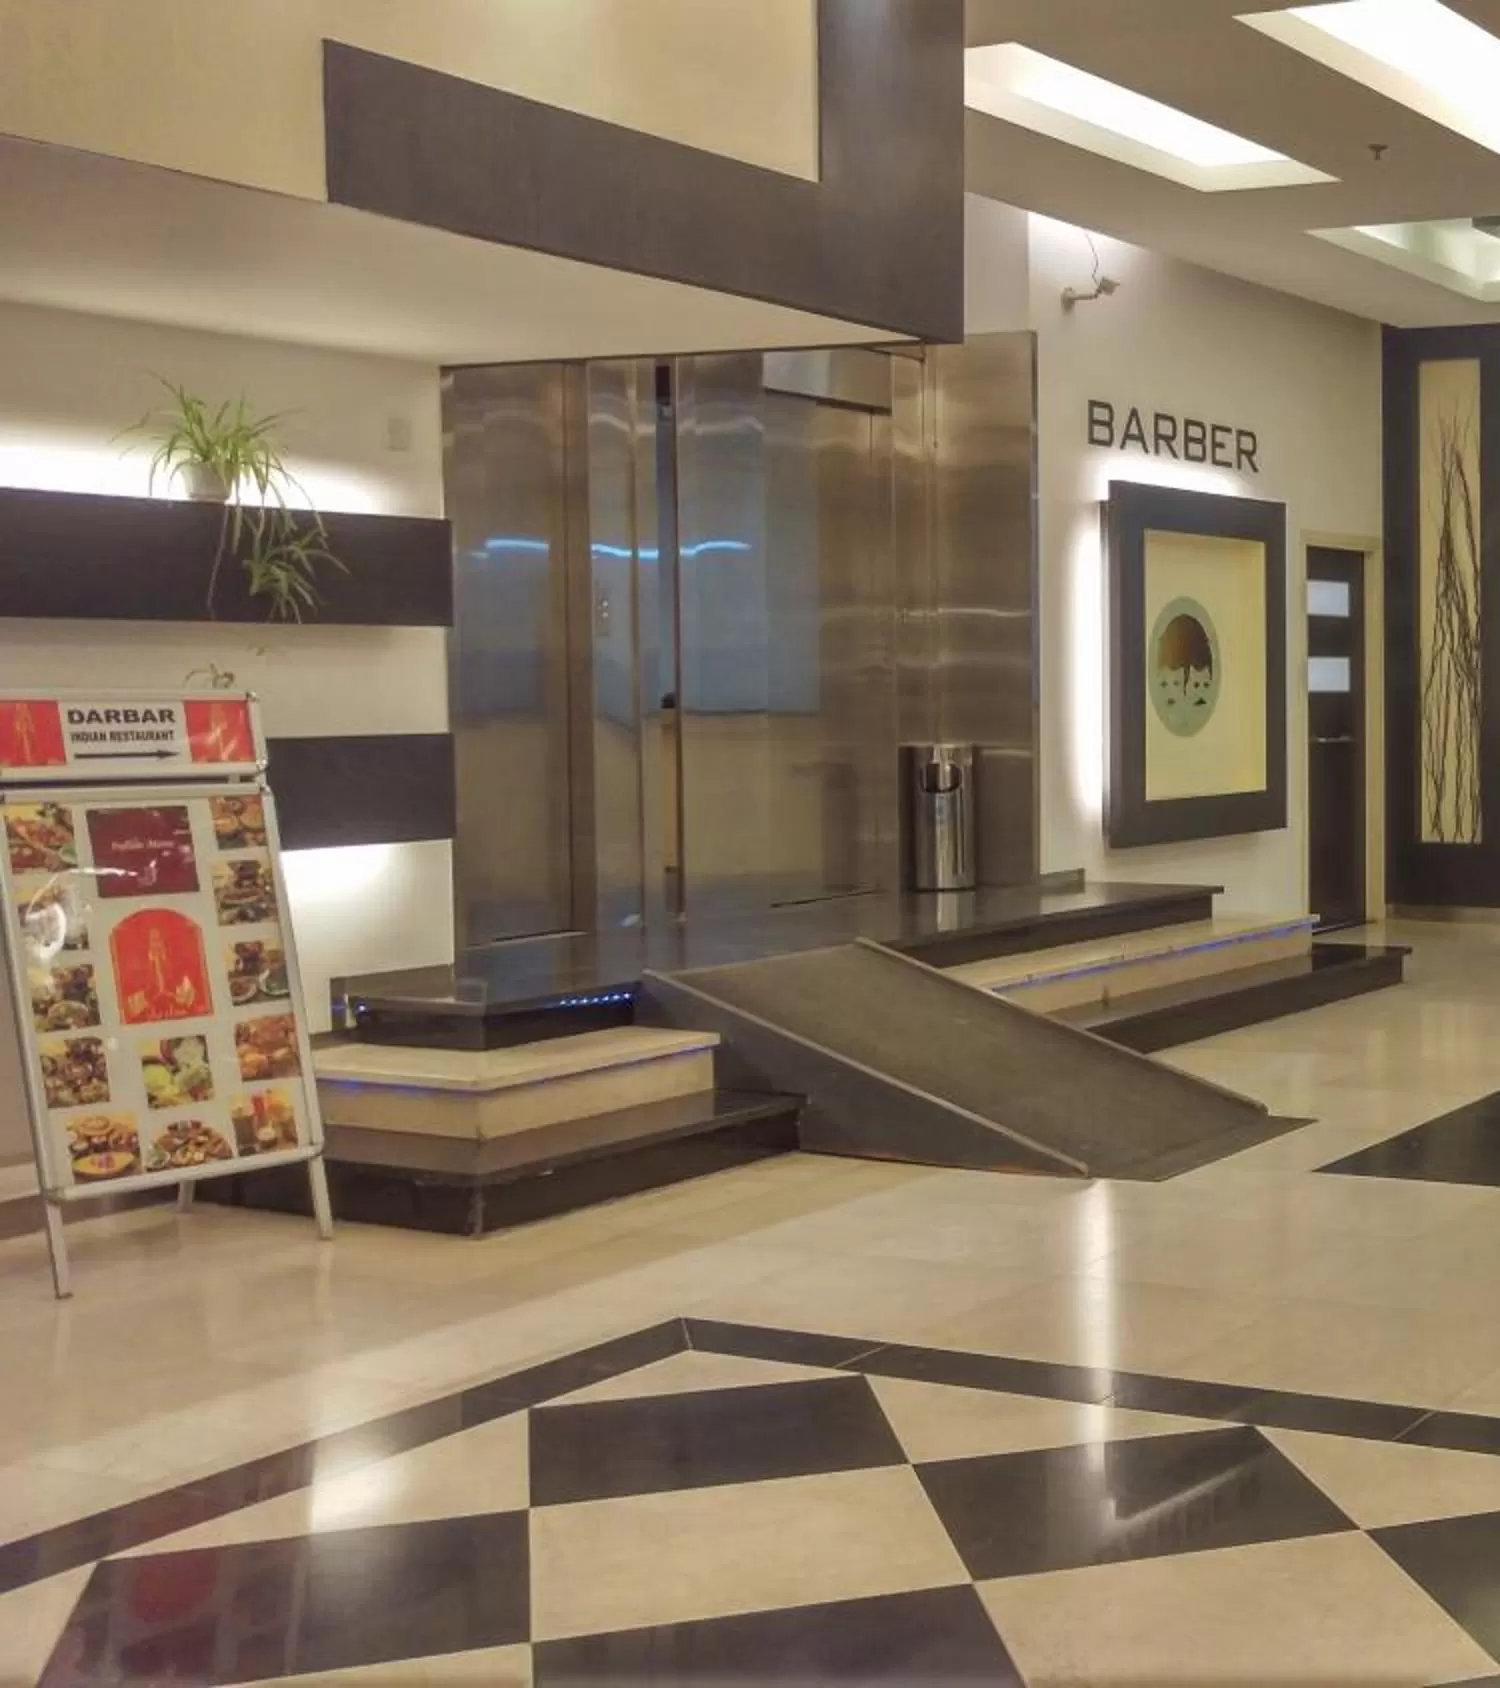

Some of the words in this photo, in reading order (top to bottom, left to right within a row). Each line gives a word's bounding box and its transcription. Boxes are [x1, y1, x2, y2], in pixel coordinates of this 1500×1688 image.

[1087, 399, 1259, 473] BARBER
[67, 708, 176, 725] DARBAR
[71, 730, 107, 743] INDIAN
[109, 729, 175, 742] RESTAURANT
